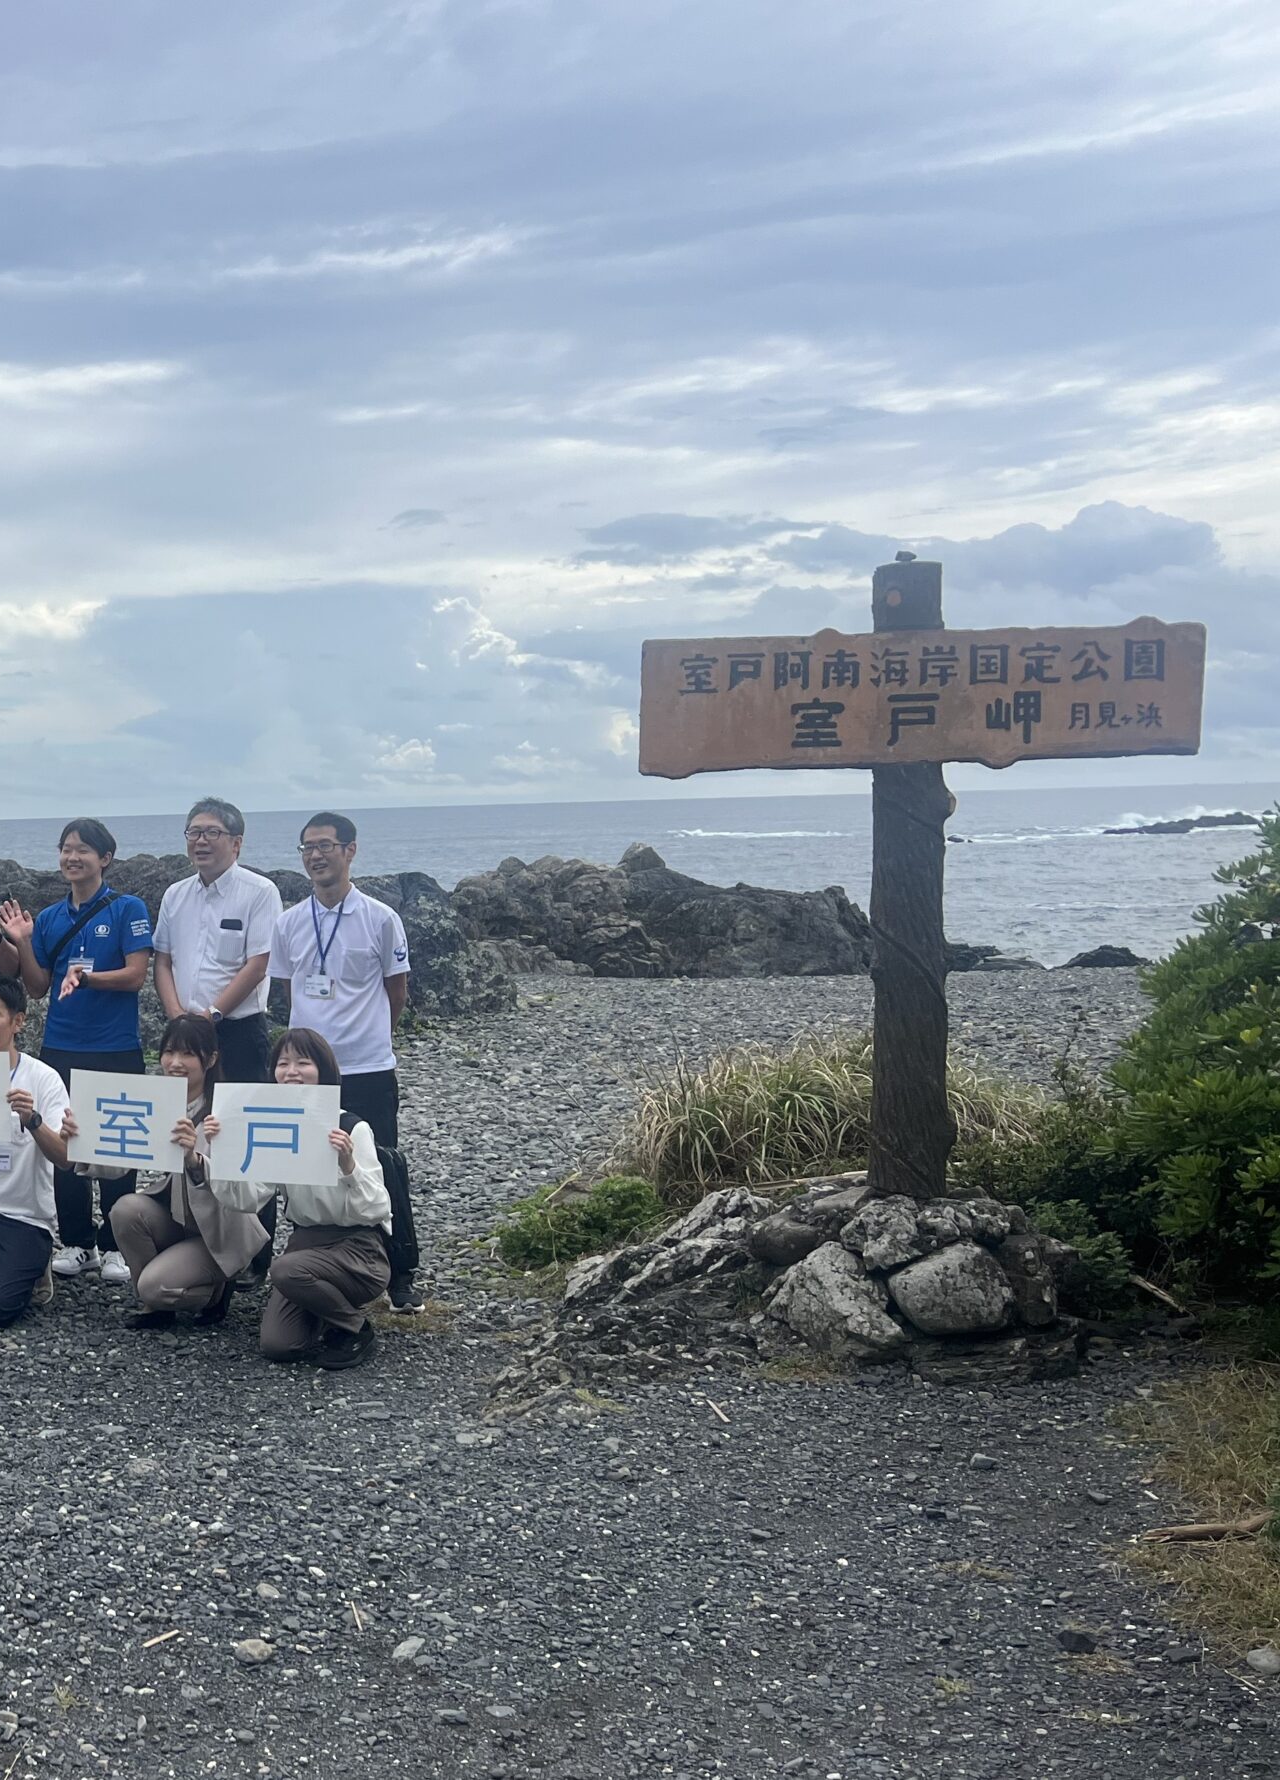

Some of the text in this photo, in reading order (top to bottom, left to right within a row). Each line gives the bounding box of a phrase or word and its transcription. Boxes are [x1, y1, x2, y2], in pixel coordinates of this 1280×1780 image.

[679, 639, 1165, 695] 室戸阿南海岸国定公園
[94, 1092, 154, 1161] 室
[240, 1106, 306, 1173] 戸
